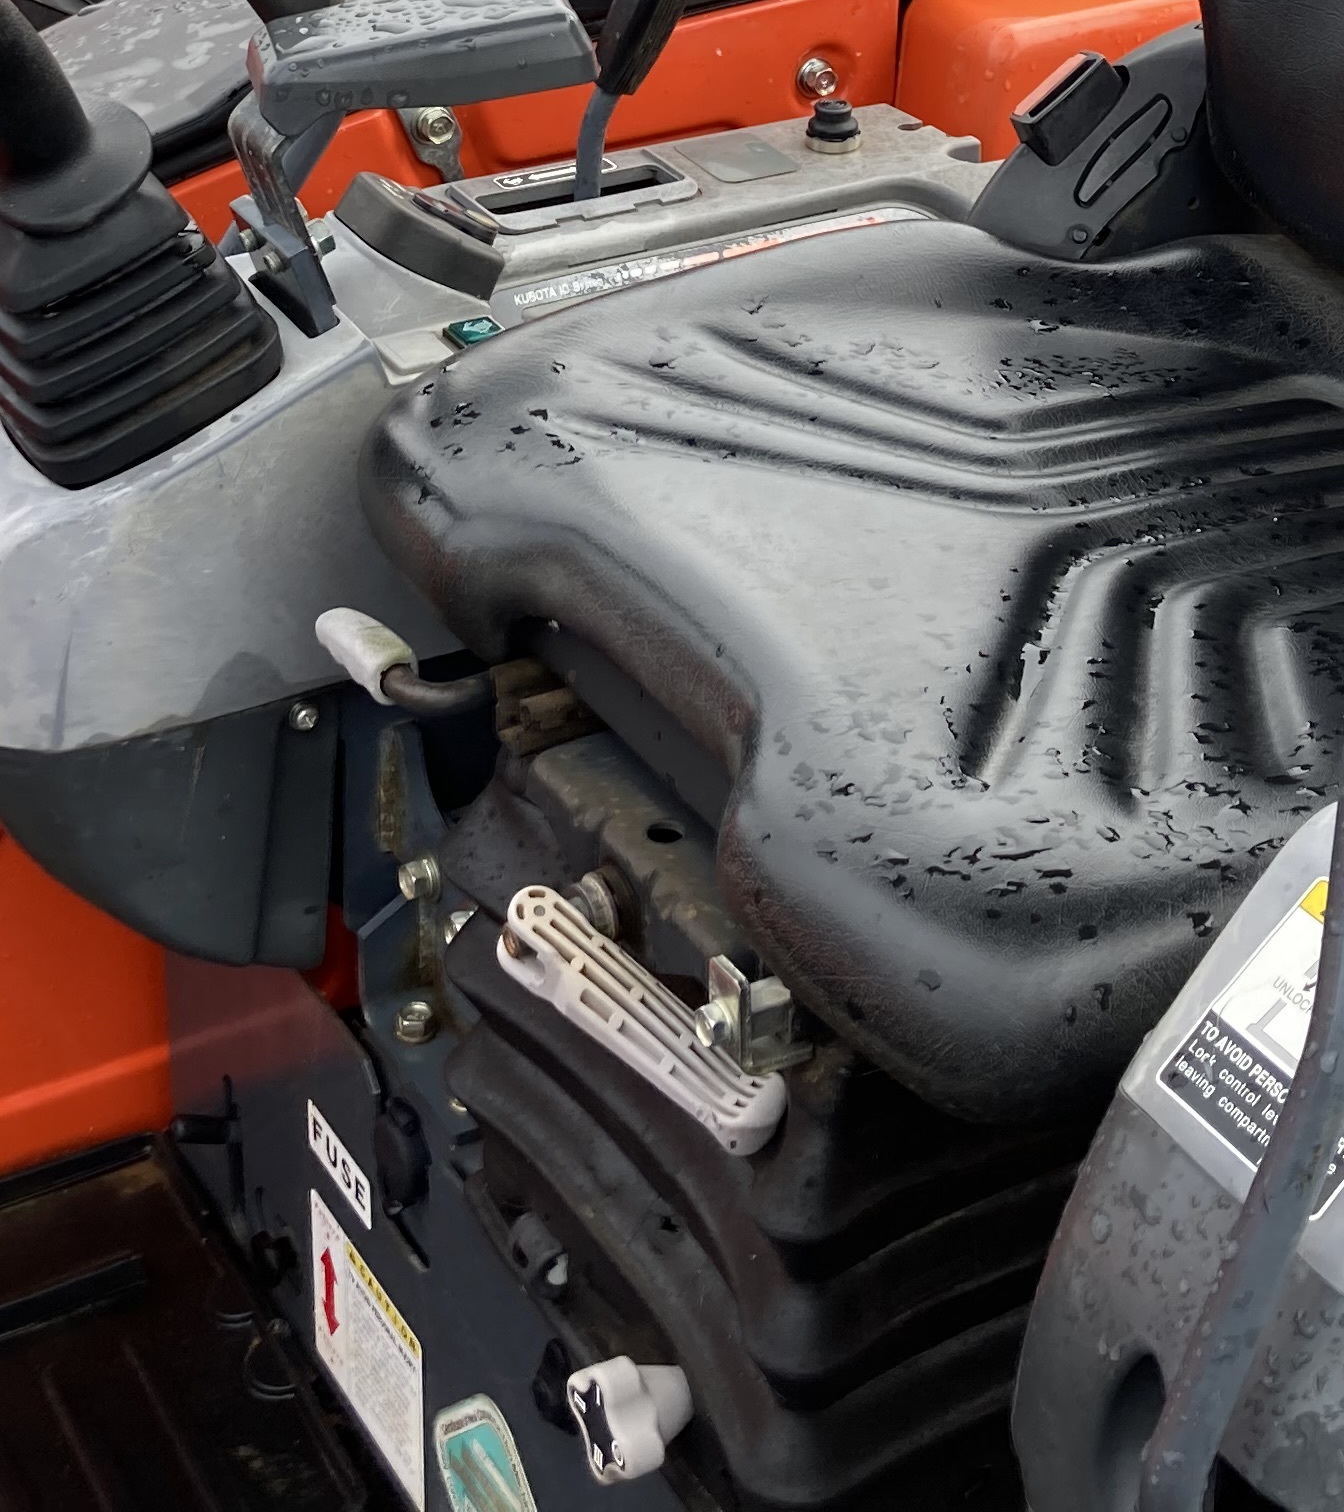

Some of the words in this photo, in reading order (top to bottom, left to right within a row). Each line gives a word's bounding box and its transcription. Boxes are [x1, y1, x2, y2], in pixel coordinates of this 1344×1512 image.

[513, 287, 558, 306] KUBOTA
[1200, 1020, 1220, 1042] TO
[1214, 1036, 1254, 1072] AVOID
[1174, 1055, 1216, 1099] leaving
[1218, 1068, 1262, 1108] control
[312, 1116, 366, 1212] FUSE
